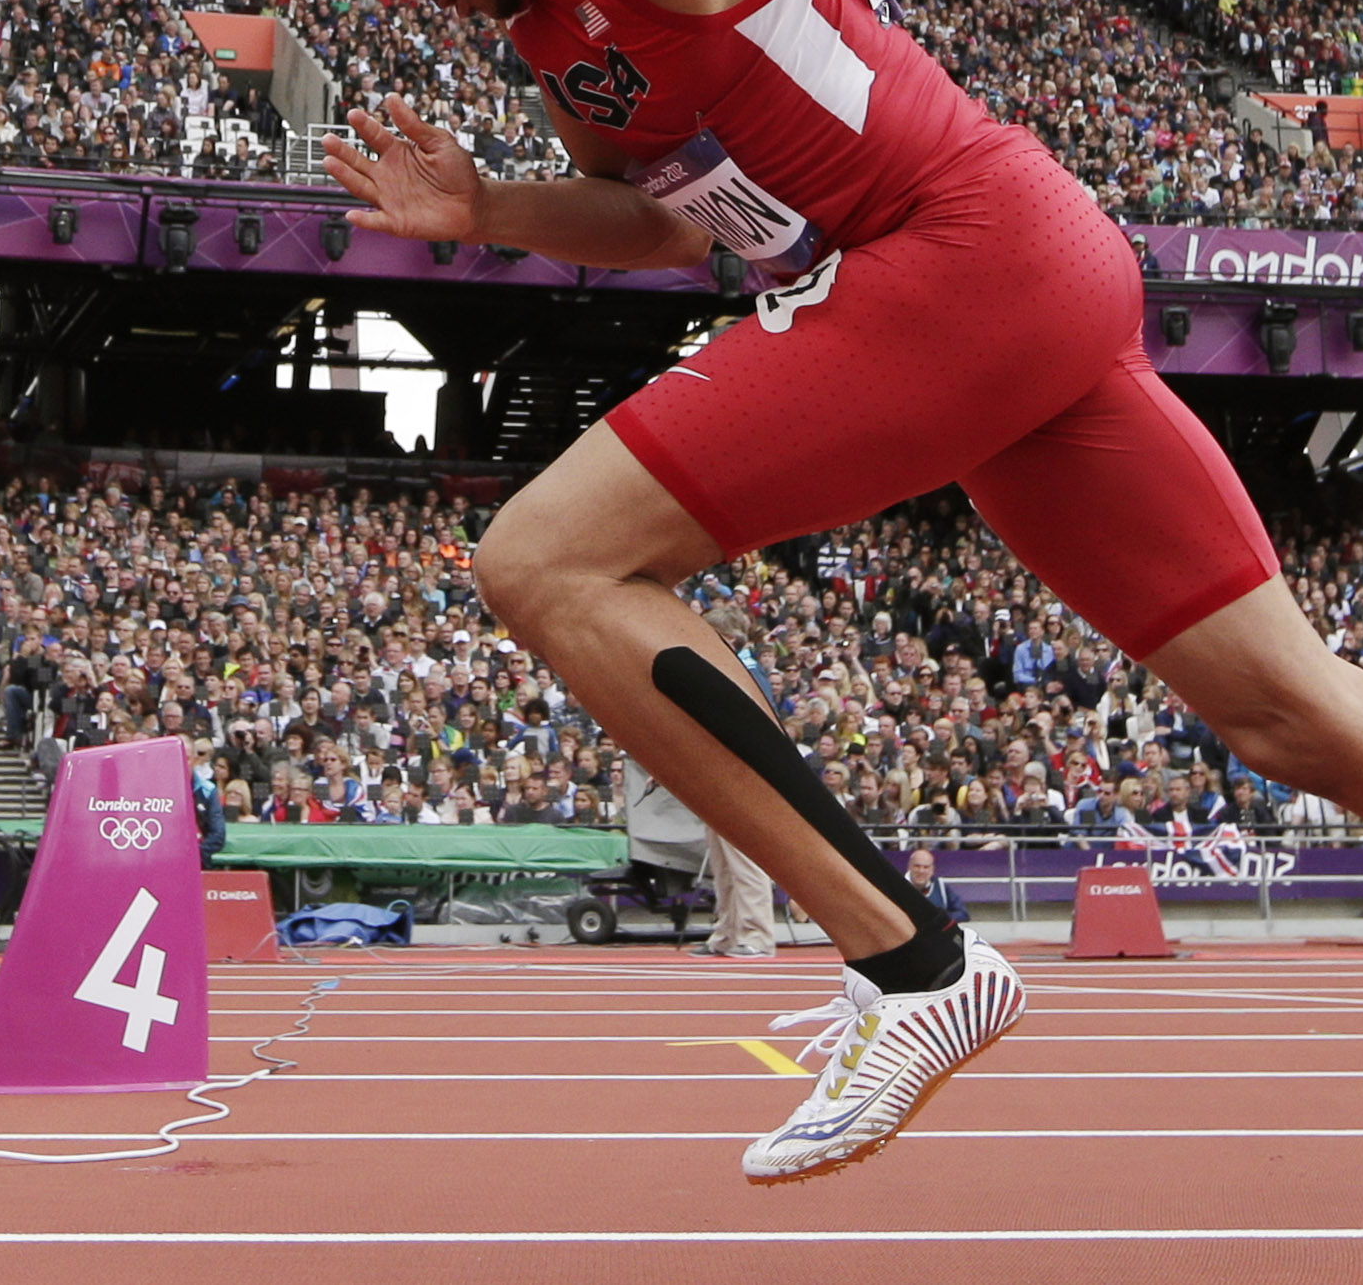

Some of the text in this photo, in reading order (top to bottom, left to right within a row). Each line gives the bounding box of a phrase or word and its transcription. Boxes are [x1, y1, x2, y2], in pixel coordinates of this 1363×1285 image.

[88, 796, 174, 813] London 2012
[1102, 884, 1142, 896] OMEGA
[72, 885, 180, 1053] 4
